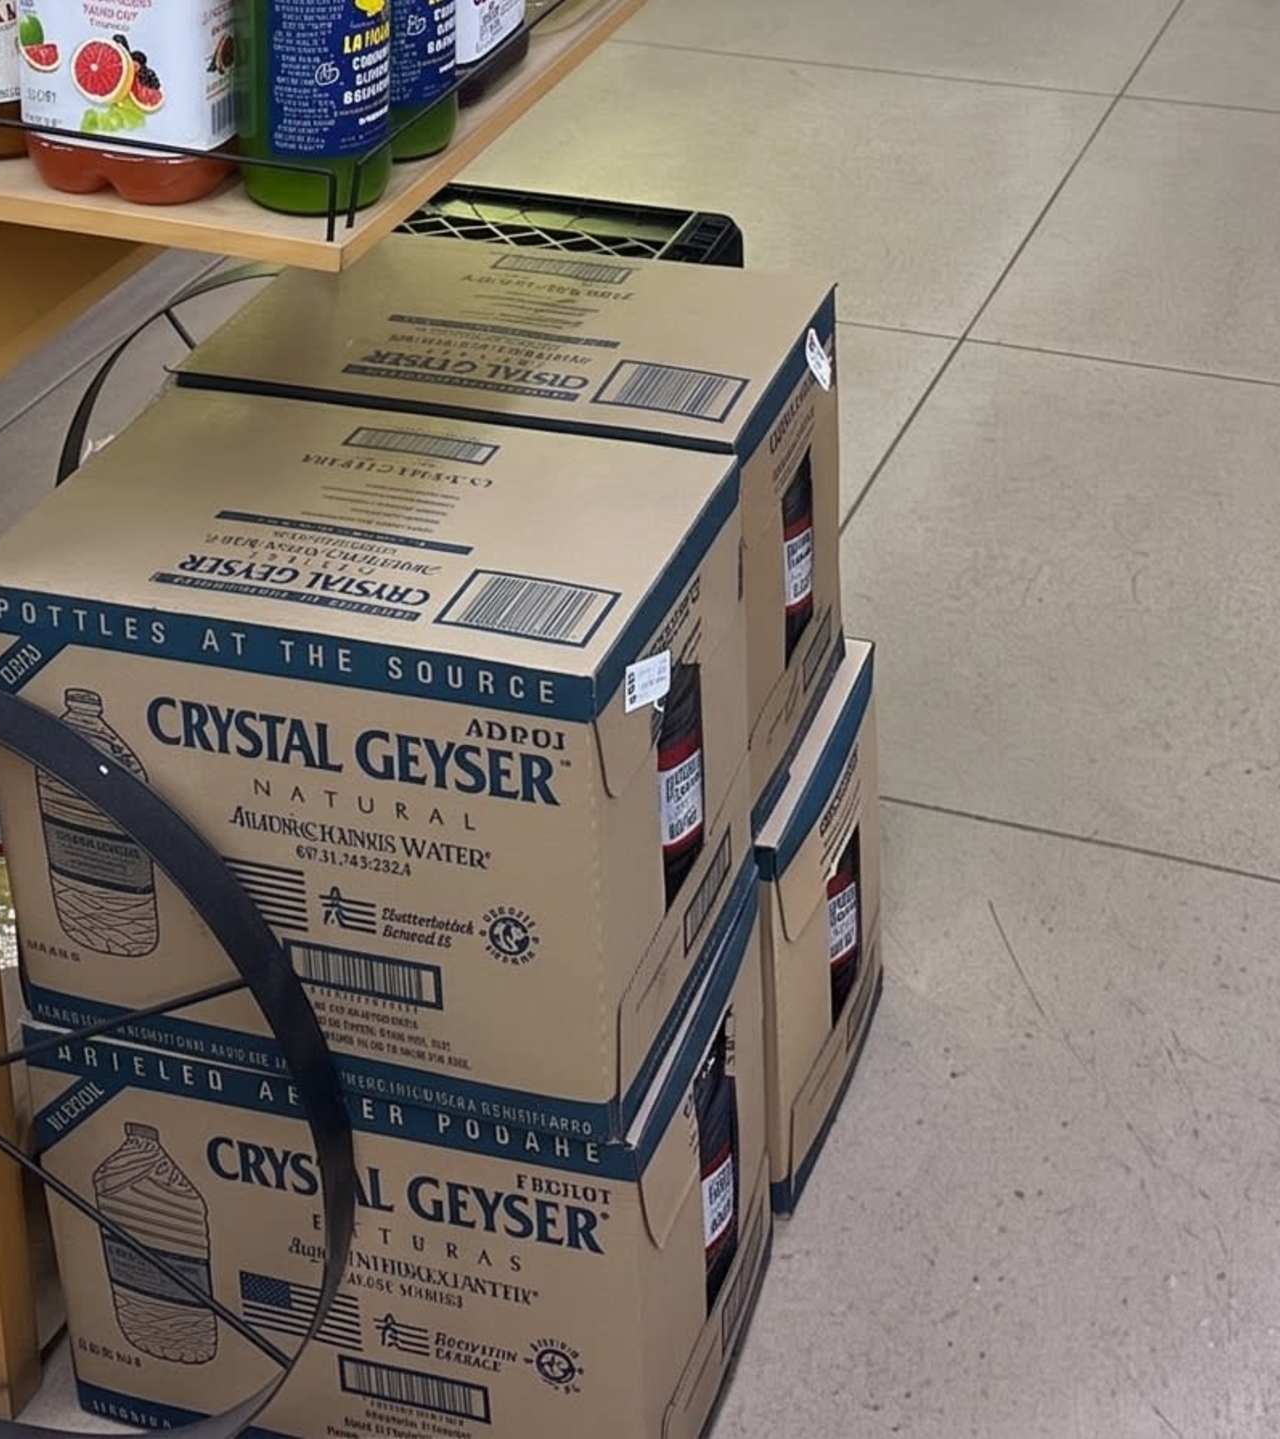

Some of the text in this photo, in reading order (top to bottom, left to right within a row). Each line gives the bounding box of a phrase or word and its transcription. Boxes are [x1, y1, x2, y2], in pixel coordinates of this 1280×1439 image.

[178, 551, 301, 586] GEYSER
[201, 630, 247, 657] AT
[279, 638, 354, 673] THE
[388, 655, 559, 705] SOURCE
[146, 696, 562, 808] CRYSTAL GEYSER
[252, 777, 477, 832] NATURAL
[206, 1135, 604, 1255] CRYSAL GEYSER
